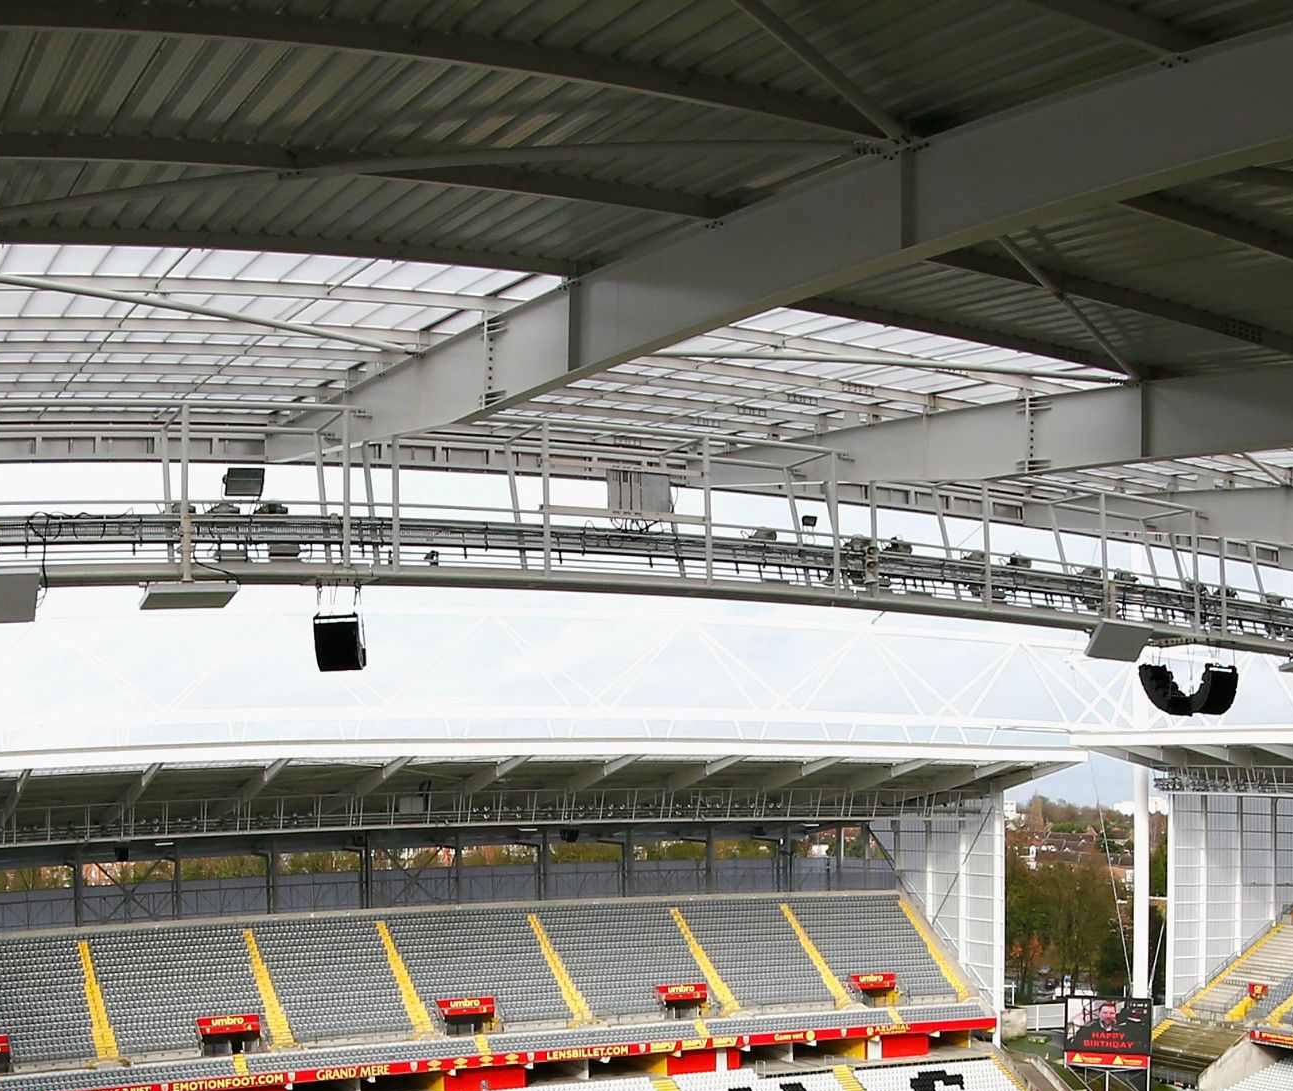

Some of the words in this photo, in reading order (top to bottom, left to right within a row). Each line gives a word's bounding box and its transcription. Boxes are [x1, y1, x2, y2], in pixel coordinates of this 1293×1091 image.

[859, 973, 884, 983] umbro
[667, 984, 695, 993] umbro
[449, 998, 480, 1008] umbro
[211, 1015, 244, 1026] umbro
[875, 1024, 911, 1033] AZURIAL
[792, 1032, 804, 1040] vert
[1091, 1031, 1125, 1040] HAPPY
[1083, 1040, 1135, 1049] BIRTHDAY
[546, 1045, 629, 1061] LENSBILLET.COM
